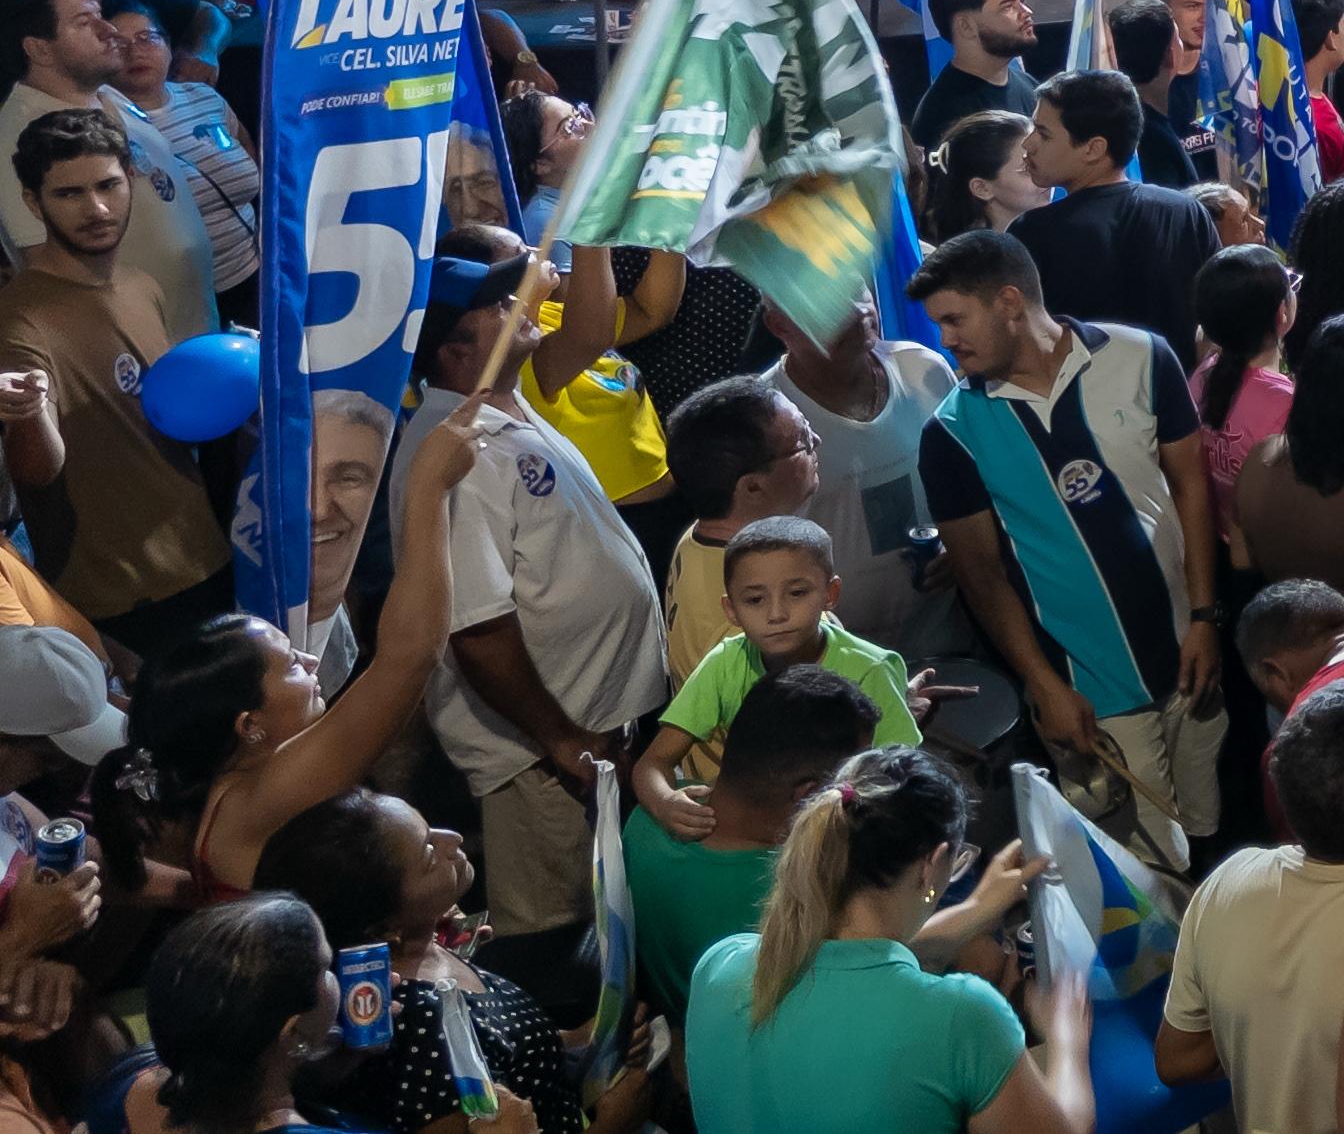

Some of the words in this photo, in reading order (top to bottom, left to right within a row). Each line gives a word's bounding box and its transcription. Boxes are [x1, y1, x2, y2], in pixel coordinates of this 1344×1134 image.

[340, 47, 381, 72] CEL.
[386, 41, 428, 68] SILVA
[432, 37, 459, 62] NET
[298, 130, 450, 374] 5
[1065, 478, 1089, 499] 55
